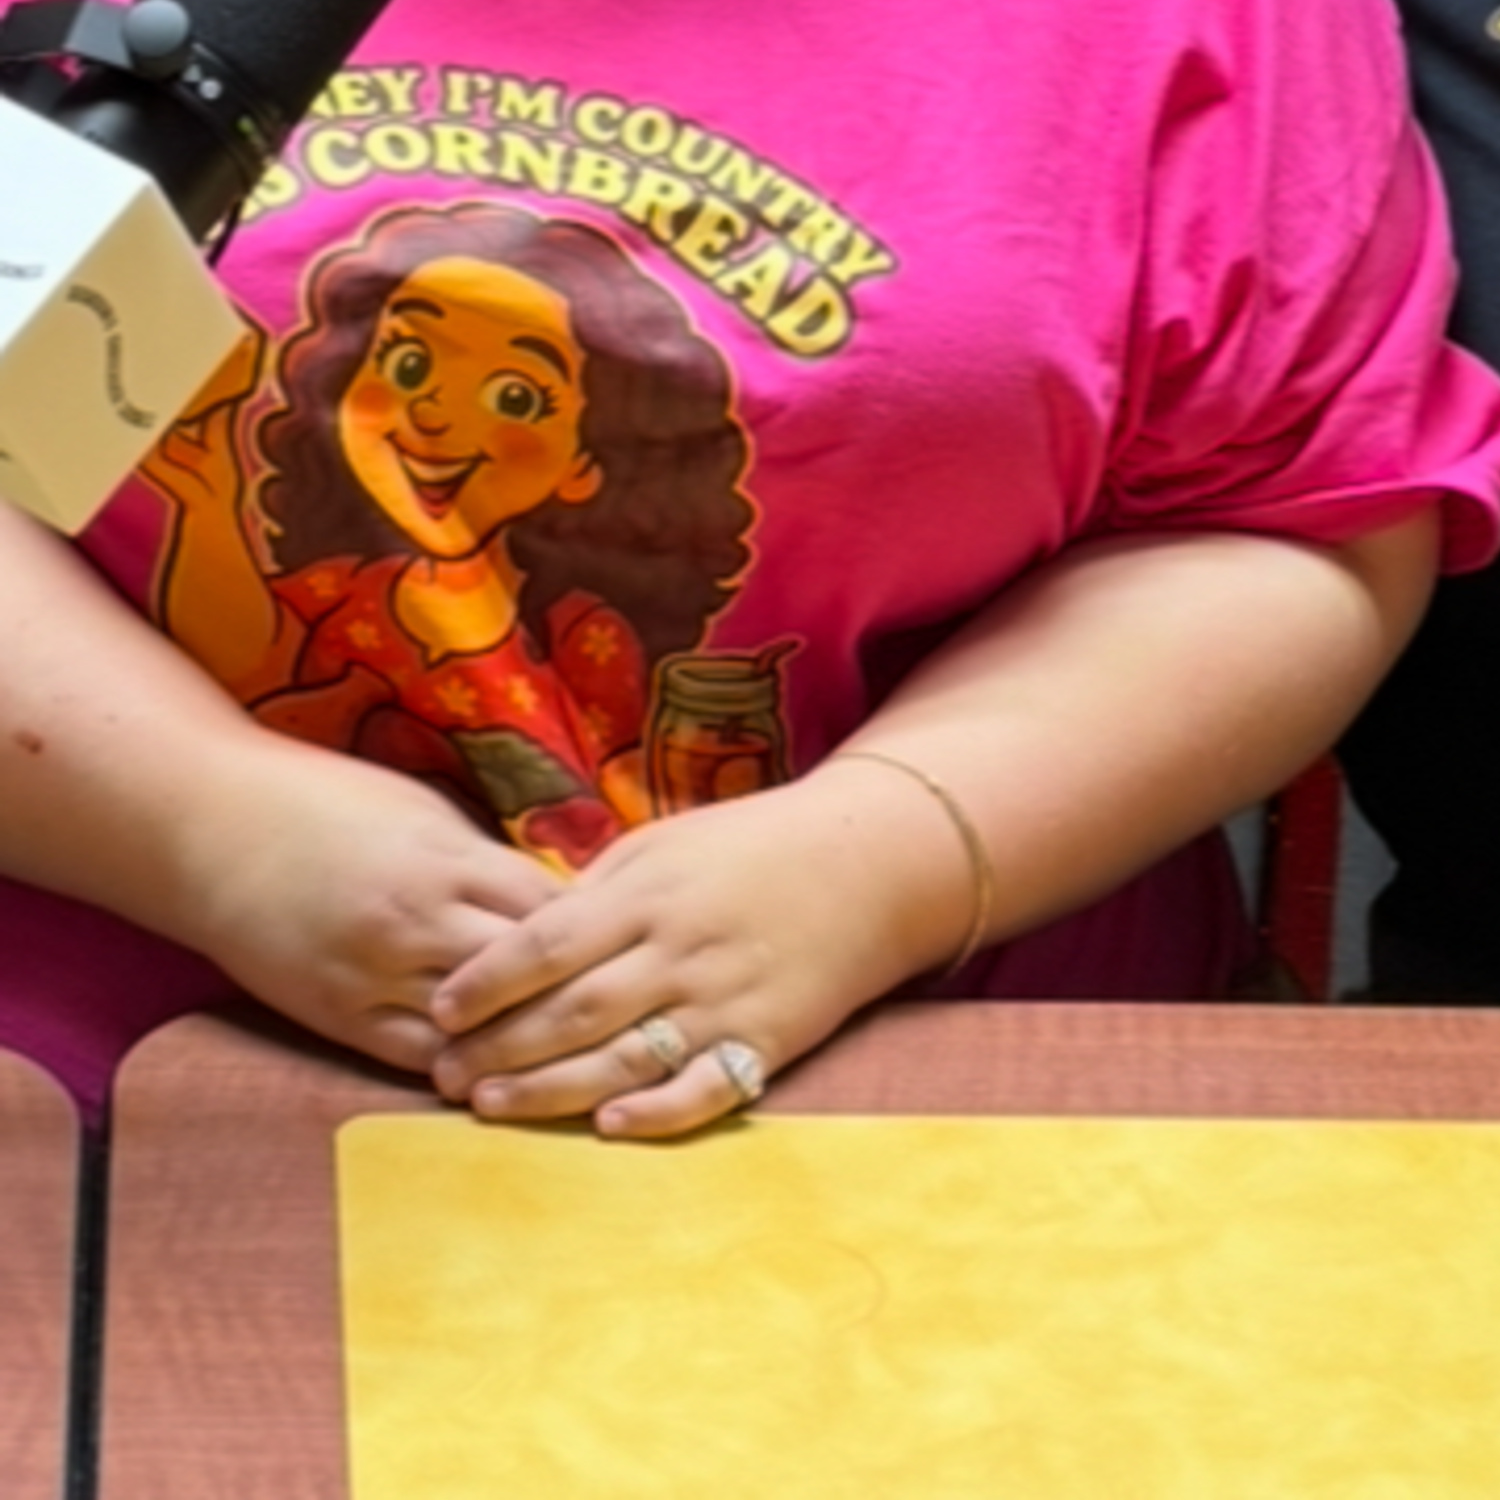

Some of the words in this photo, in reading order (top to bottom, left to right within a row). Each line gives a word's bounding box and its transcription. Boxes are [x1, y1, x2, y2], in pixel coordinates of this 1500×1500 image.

[305, 121, 852, 360] CORNBREAD
[445, 70, 564, 130] I'M
[573, 97, 897, 286] COUNTRY
